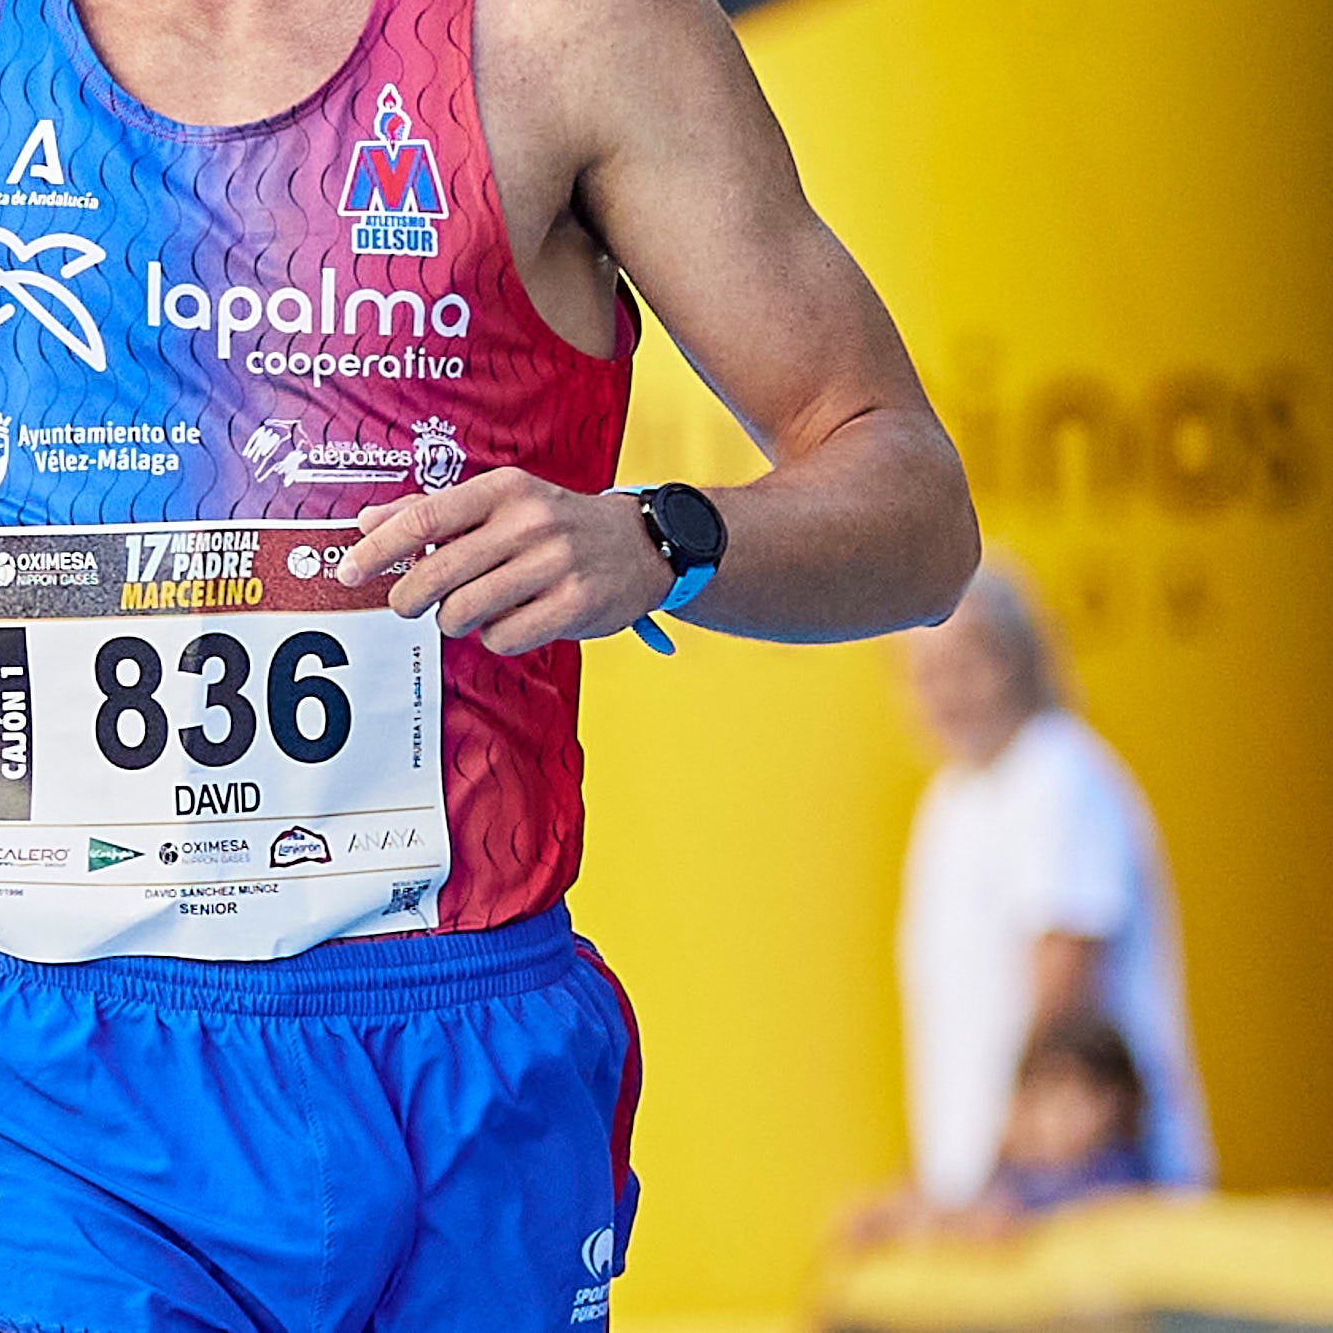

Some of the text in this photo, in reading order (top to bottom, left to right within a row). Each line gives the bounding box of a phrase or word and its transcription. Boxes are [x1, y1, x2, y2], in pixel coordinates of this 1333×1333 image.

[11, 189, 28, 206] de
[28, 191, 99, 210] Andalucía
[366, 215, 425, 228] ATLETISMO
[357, 228, 433, 252] DELSUR
[147, 261, 470, 359] lapalma
[245, 346, 464, 388] cooperativa
[18, 421, 201, 451] Ayuntamiento de
[34, 448, 180, 476] Vélez-Málaga
[308, 444, 413, 469] deportes
[17, 550, 98, 572] OXIMESA
[125, 531, 260, 582] 17 MEMORIAL
[172, 551, 254, 581] PADRE
[17, 572, 99, 586] NIPPON GASES
[120, 577, 264, 610] MARCELINO
[0, 666, 24, 679] 1
[95, 630, 352, 770] 836
[413, 725, 422, 768] PRUEBA
[175, 782, 261, 815] DAVID
[181, 839, 250, 854] OXIMESA
[348, 828, 426, 853] ANAYA
[144, 883, 280, 899] DAVID SÁNCHEZ MUÑOZ
[179, 901, 238, 915] SENIOR
